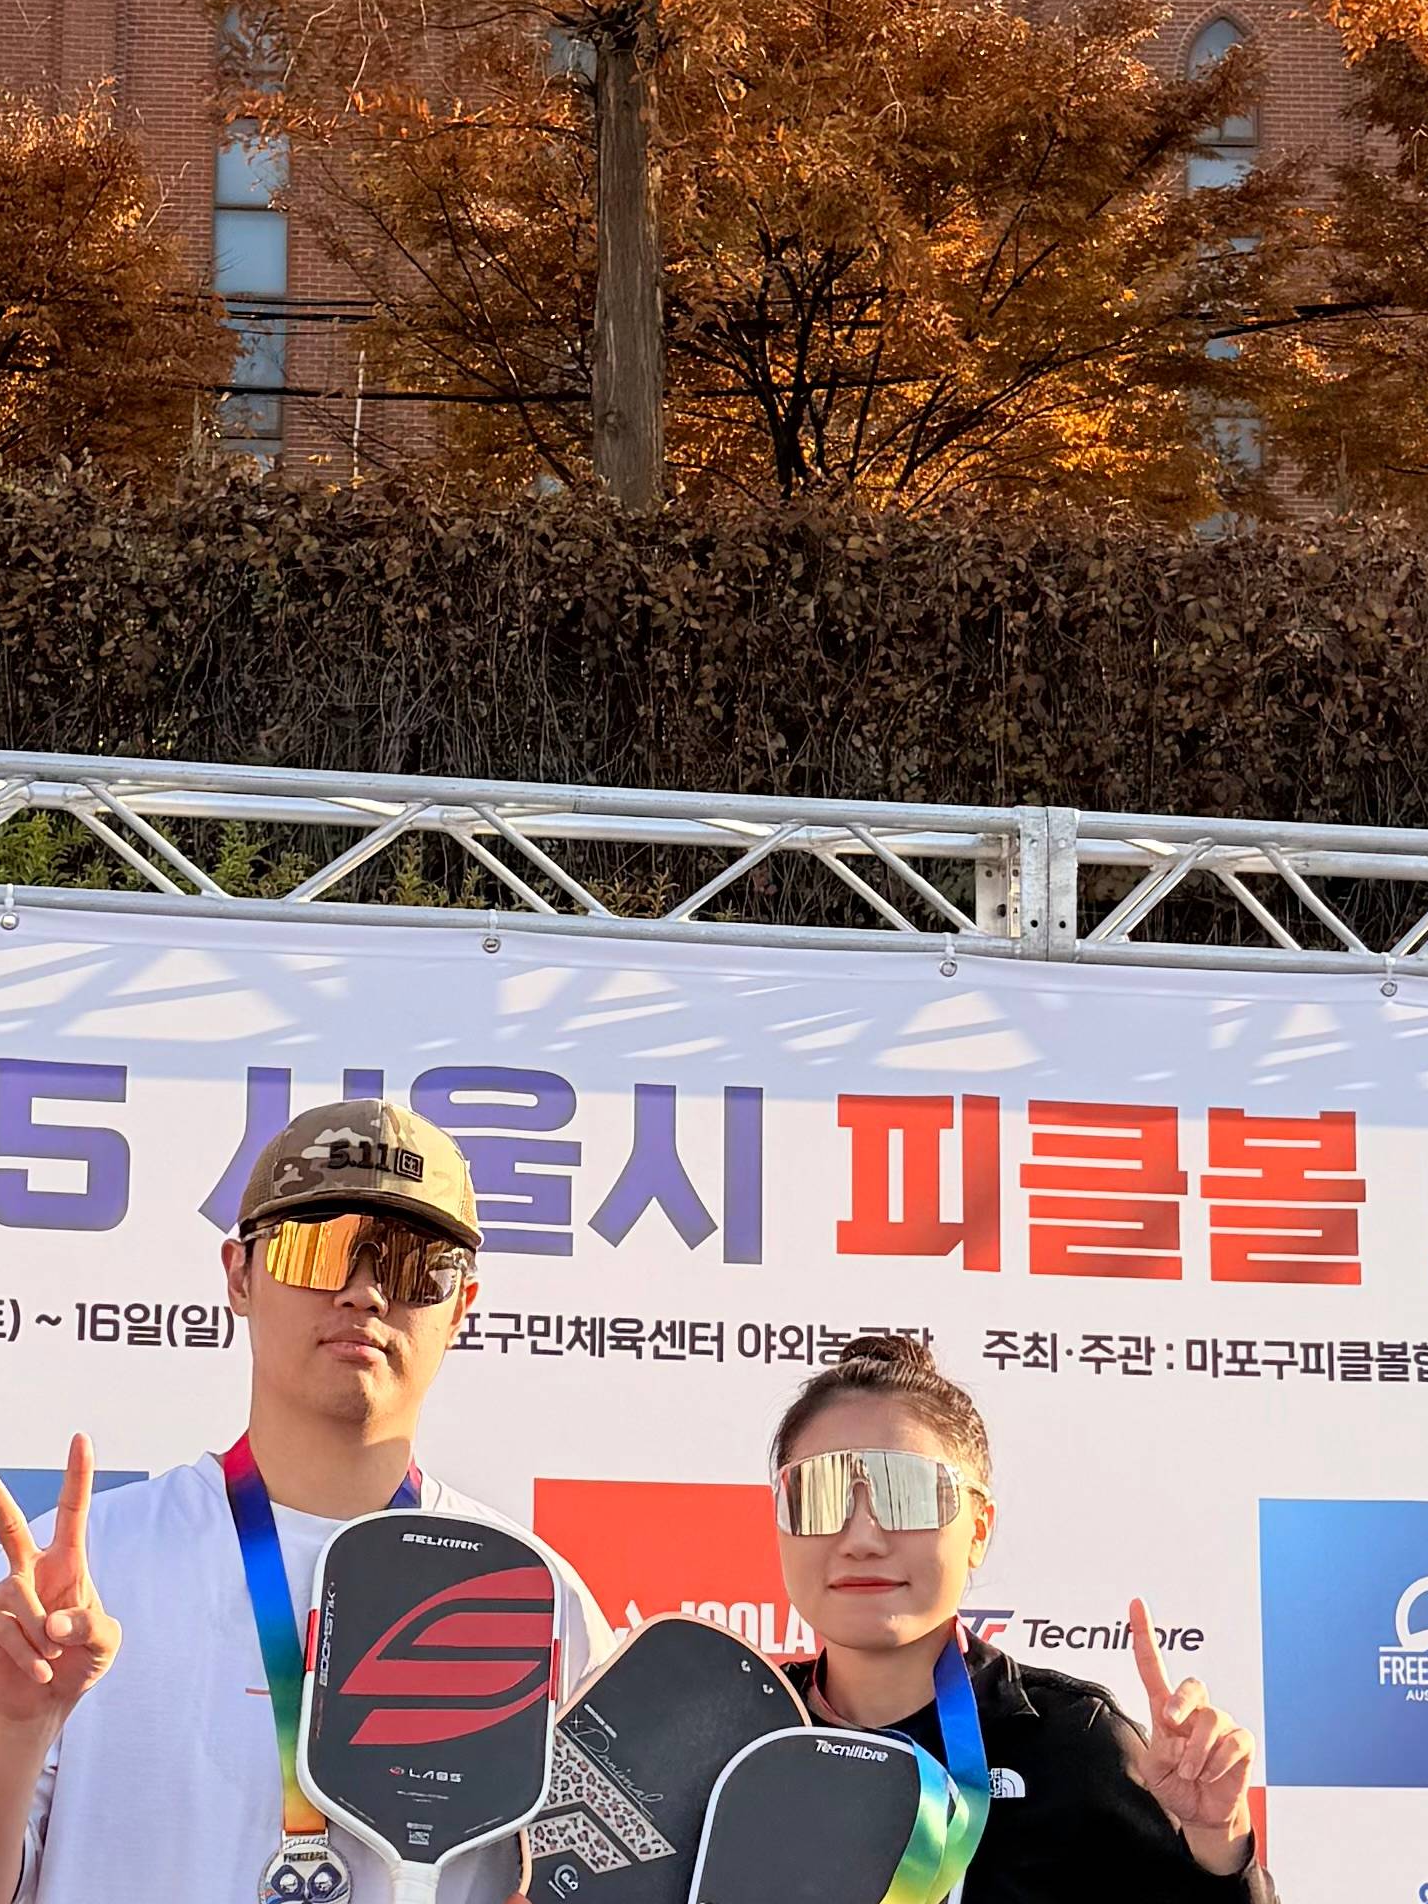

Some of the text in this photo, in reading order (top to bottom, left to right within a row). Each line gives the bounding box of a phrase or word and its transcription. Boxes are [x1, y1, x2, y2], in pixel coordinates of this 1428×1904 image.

[836, 1093, 1367, 1285] 피클볼
[76, 1302, 234, 1349] 16일(일)
[1023, 1618, 1204, 1653] Tecnifre
